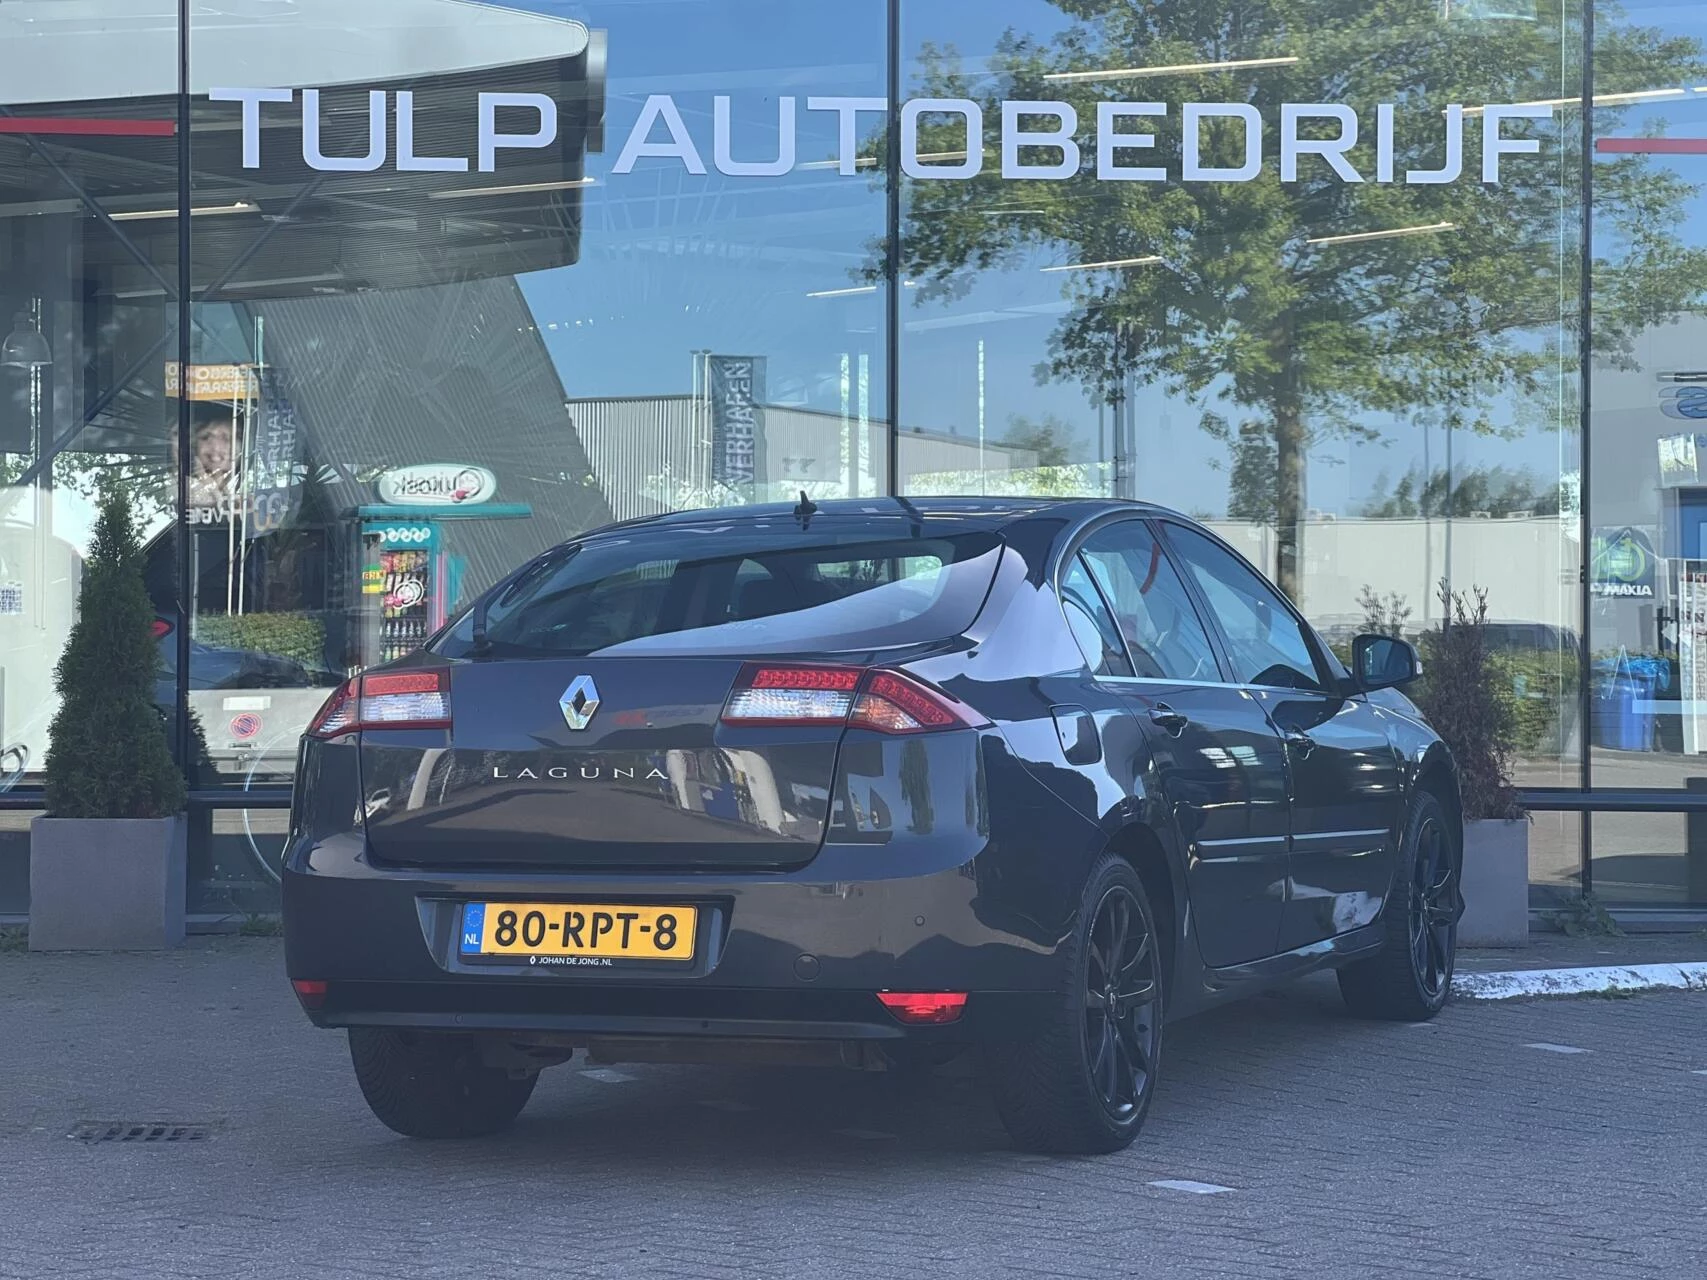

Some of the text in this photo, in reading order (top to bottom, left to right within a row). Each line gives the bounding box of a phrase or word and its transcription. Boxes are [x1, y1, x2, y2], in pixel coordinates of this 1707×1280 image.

[209, 86, 1554, 184] TULP AUTOBEDRIJF
[492, 767, 669, 780] LAGUNA
[494, 909, 678, 951] 80-RPT-8
[464, 933, 480, 945] NL
[538, 957, 565, 965] JOHAN
[566, 957, 577, 965] DE
